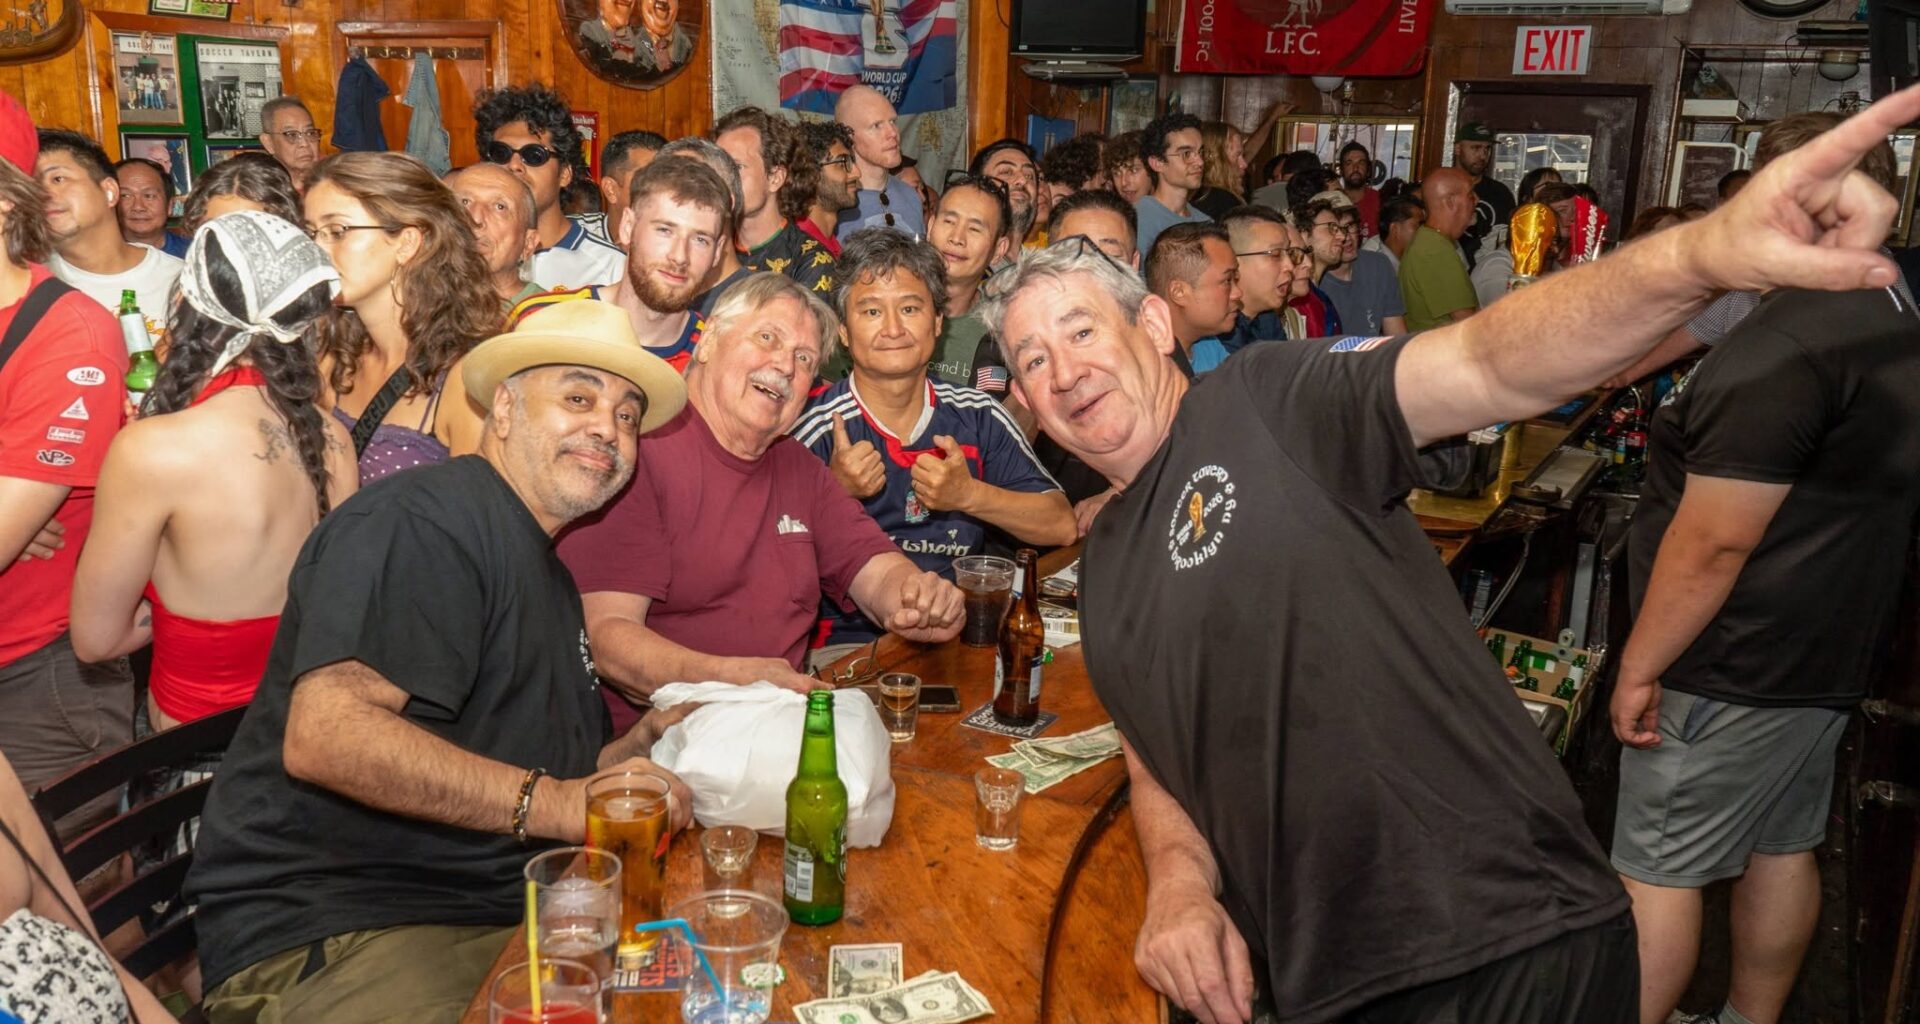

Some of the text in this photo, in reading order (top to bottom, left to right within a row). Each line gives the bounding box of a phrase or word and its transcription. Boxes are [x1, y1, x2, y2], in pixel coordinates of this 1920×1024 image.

[199, 47, 273, 58] SOCCER TAVERN
[1196, 41, 1212, 62] FC
[1264, 31, 1321, 55] L.F.C.
[1523, 29, 1585, 71] EXIT
[861, 71, 907, 84] WORLD CUP
[1577, 204, 1599, 263] weiser
